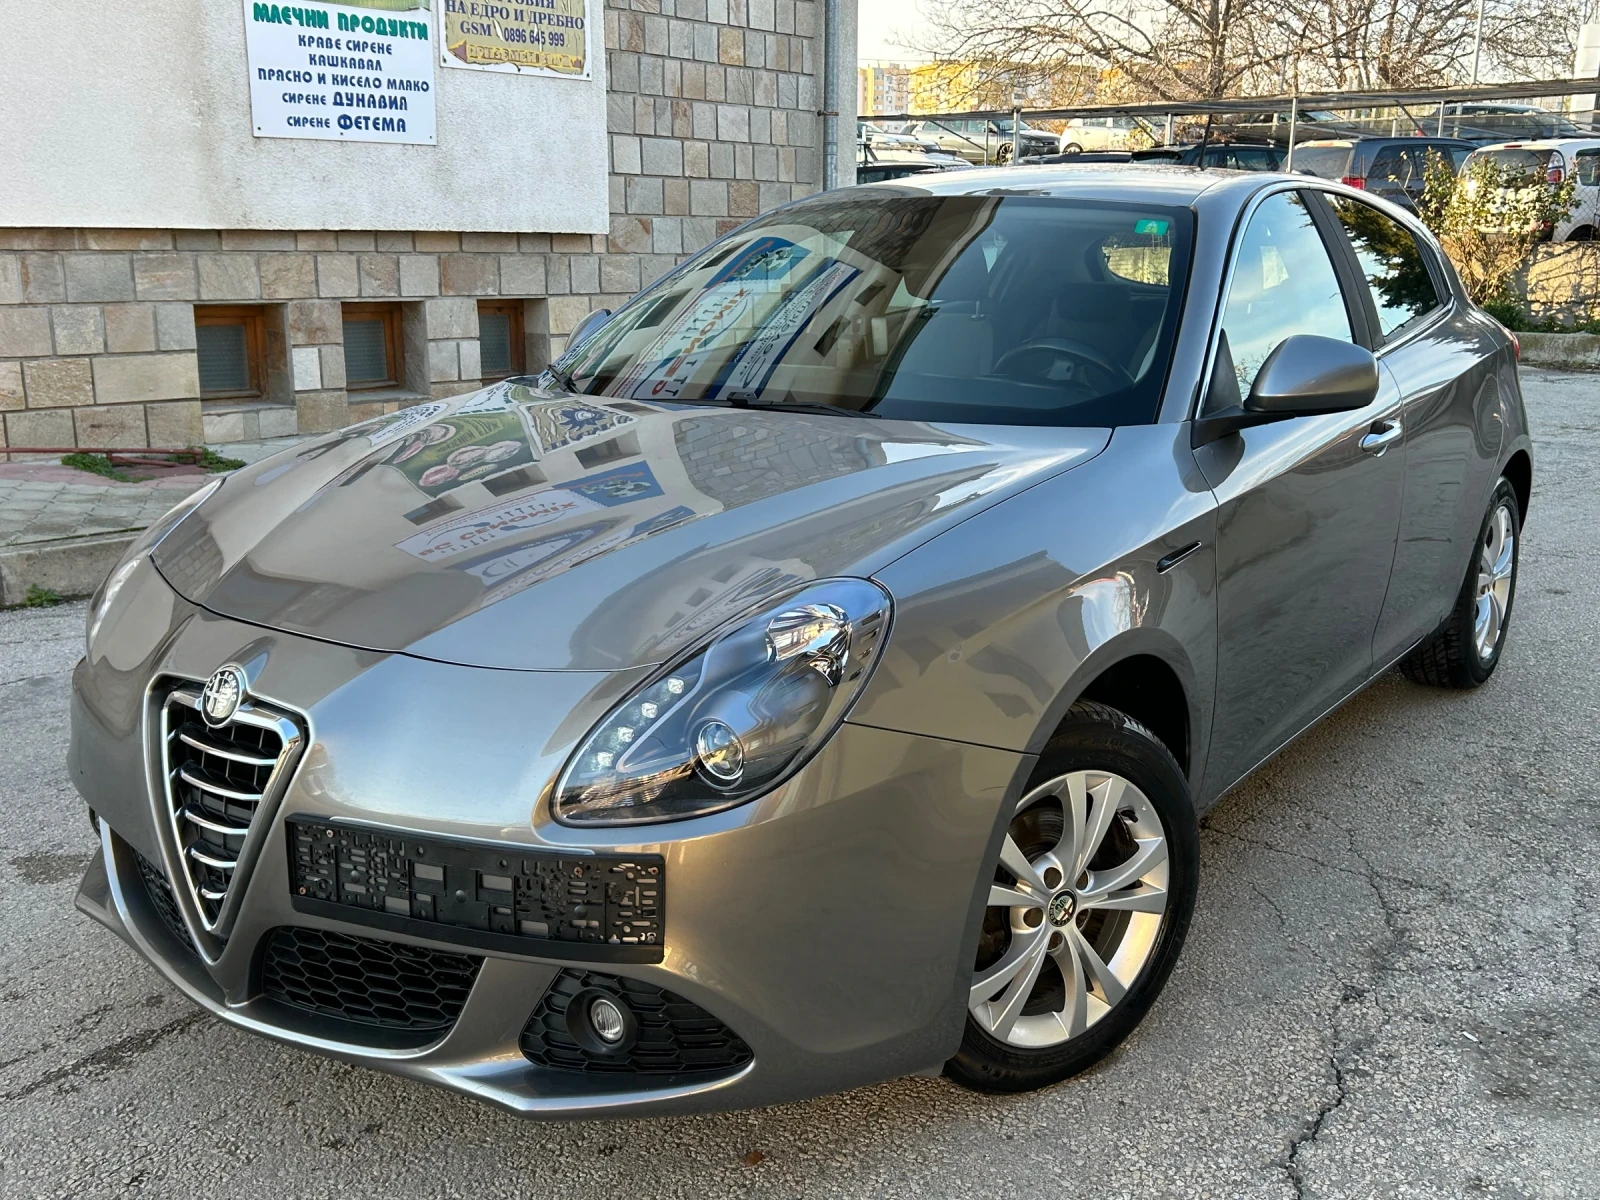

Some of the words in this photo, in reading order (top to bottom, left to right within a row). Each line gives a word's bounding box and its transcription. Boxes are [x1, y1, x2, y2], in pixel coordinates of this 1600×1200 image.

[253, 2, 329, 29] МЛЕЧНИ
[337, 12, 429, 40] ПРОДУКТИ
[445, 0, 466, 14] НА
[471, 3, 510, 20] ЕДРО
[514, 9, 524, 21] И
[529, 11, 585, 30] ДРЕБНО
[460, 20, 492, 37] GSM
[504, 27, 527, 43] 0896
[548, 32, 565, 47] 999
[298, 34, 342, 50] КРАВЕ
[346, 39, 393, 55] СИРЕНЕ
[309, 53, 383, 71] КАШКАВАЛ
[257, 67, 313, 83] ПРЯСНО
[317, 73, 327, 85] И
[331, 73, 382, 89] КИСЕЛО
[282, 92, 327, 106] СИРЕНЕ
[287, 116, 331, 129] СИРЕНЕ
[337, 114, 406, 133] ФЕТЕМА
